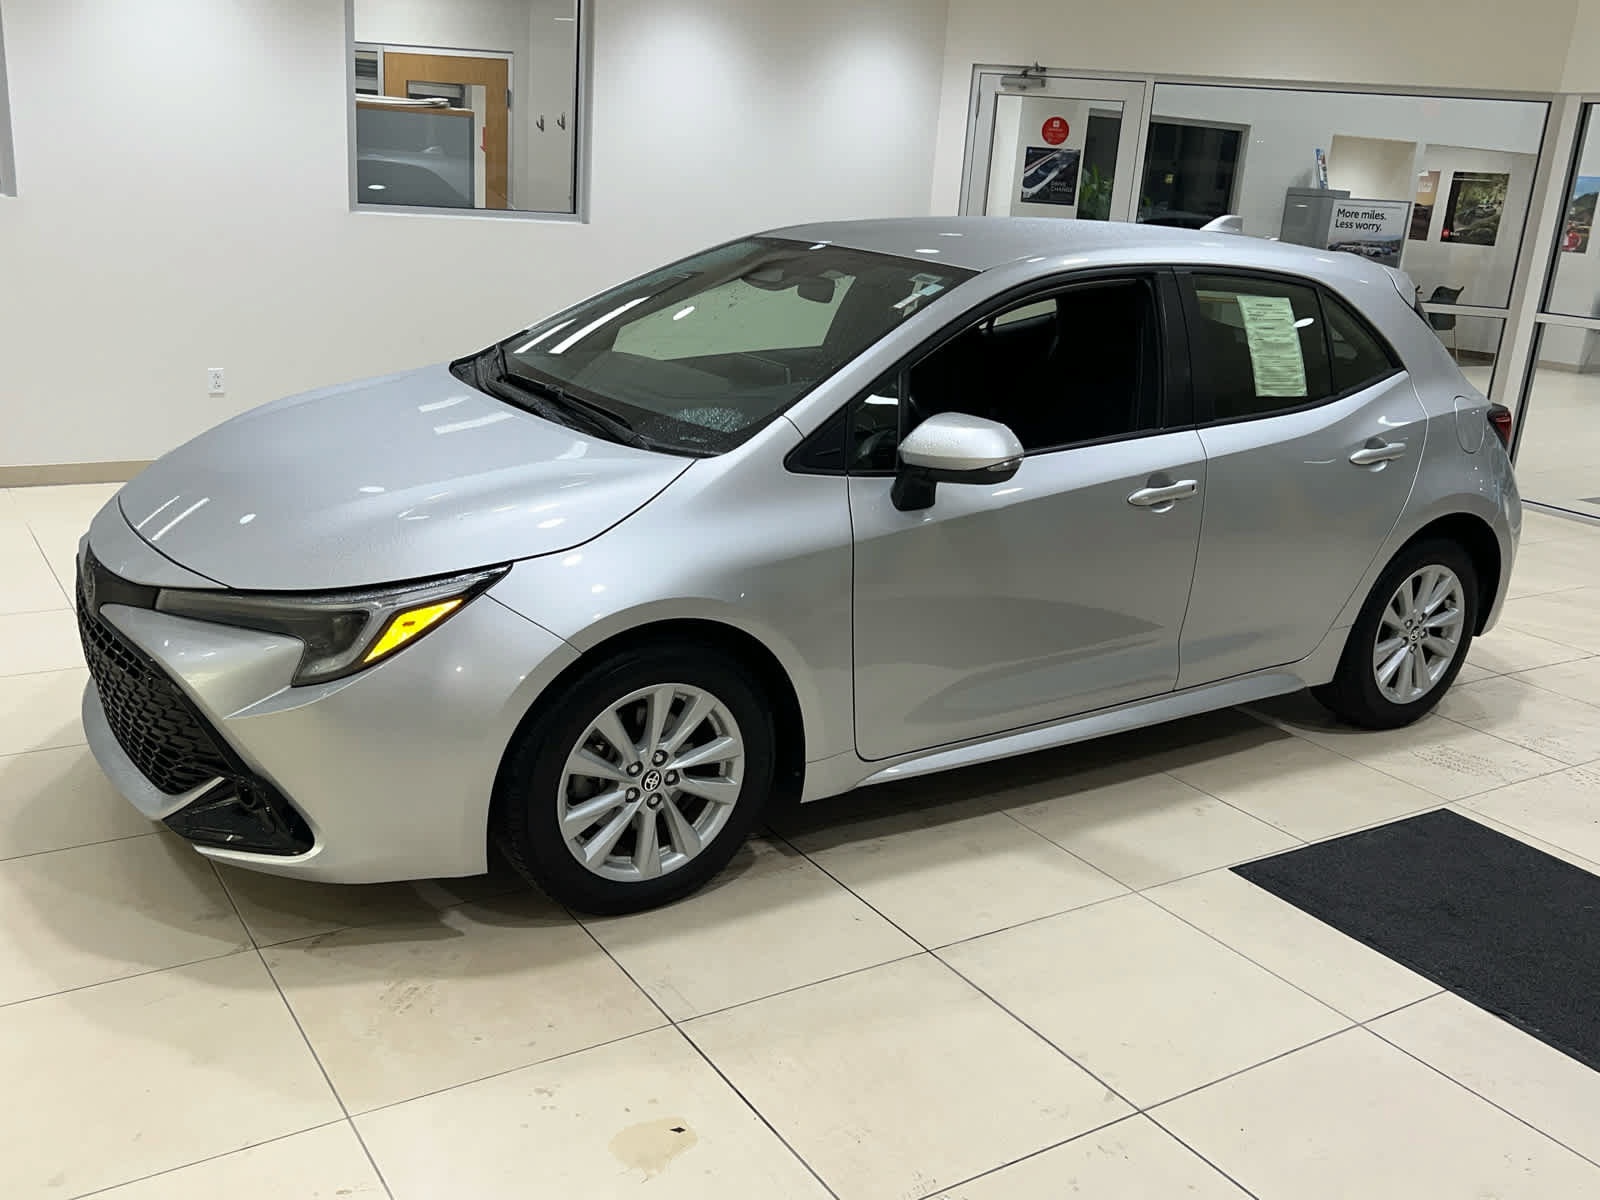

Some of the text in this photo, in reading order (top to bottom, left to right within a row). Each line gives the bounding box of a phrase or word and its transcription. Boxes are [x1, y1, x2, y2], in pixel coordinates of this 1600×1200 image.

[1337, 208, 1387, 221] More miles.
[1335, 219, 1382, 233] Less worry.
